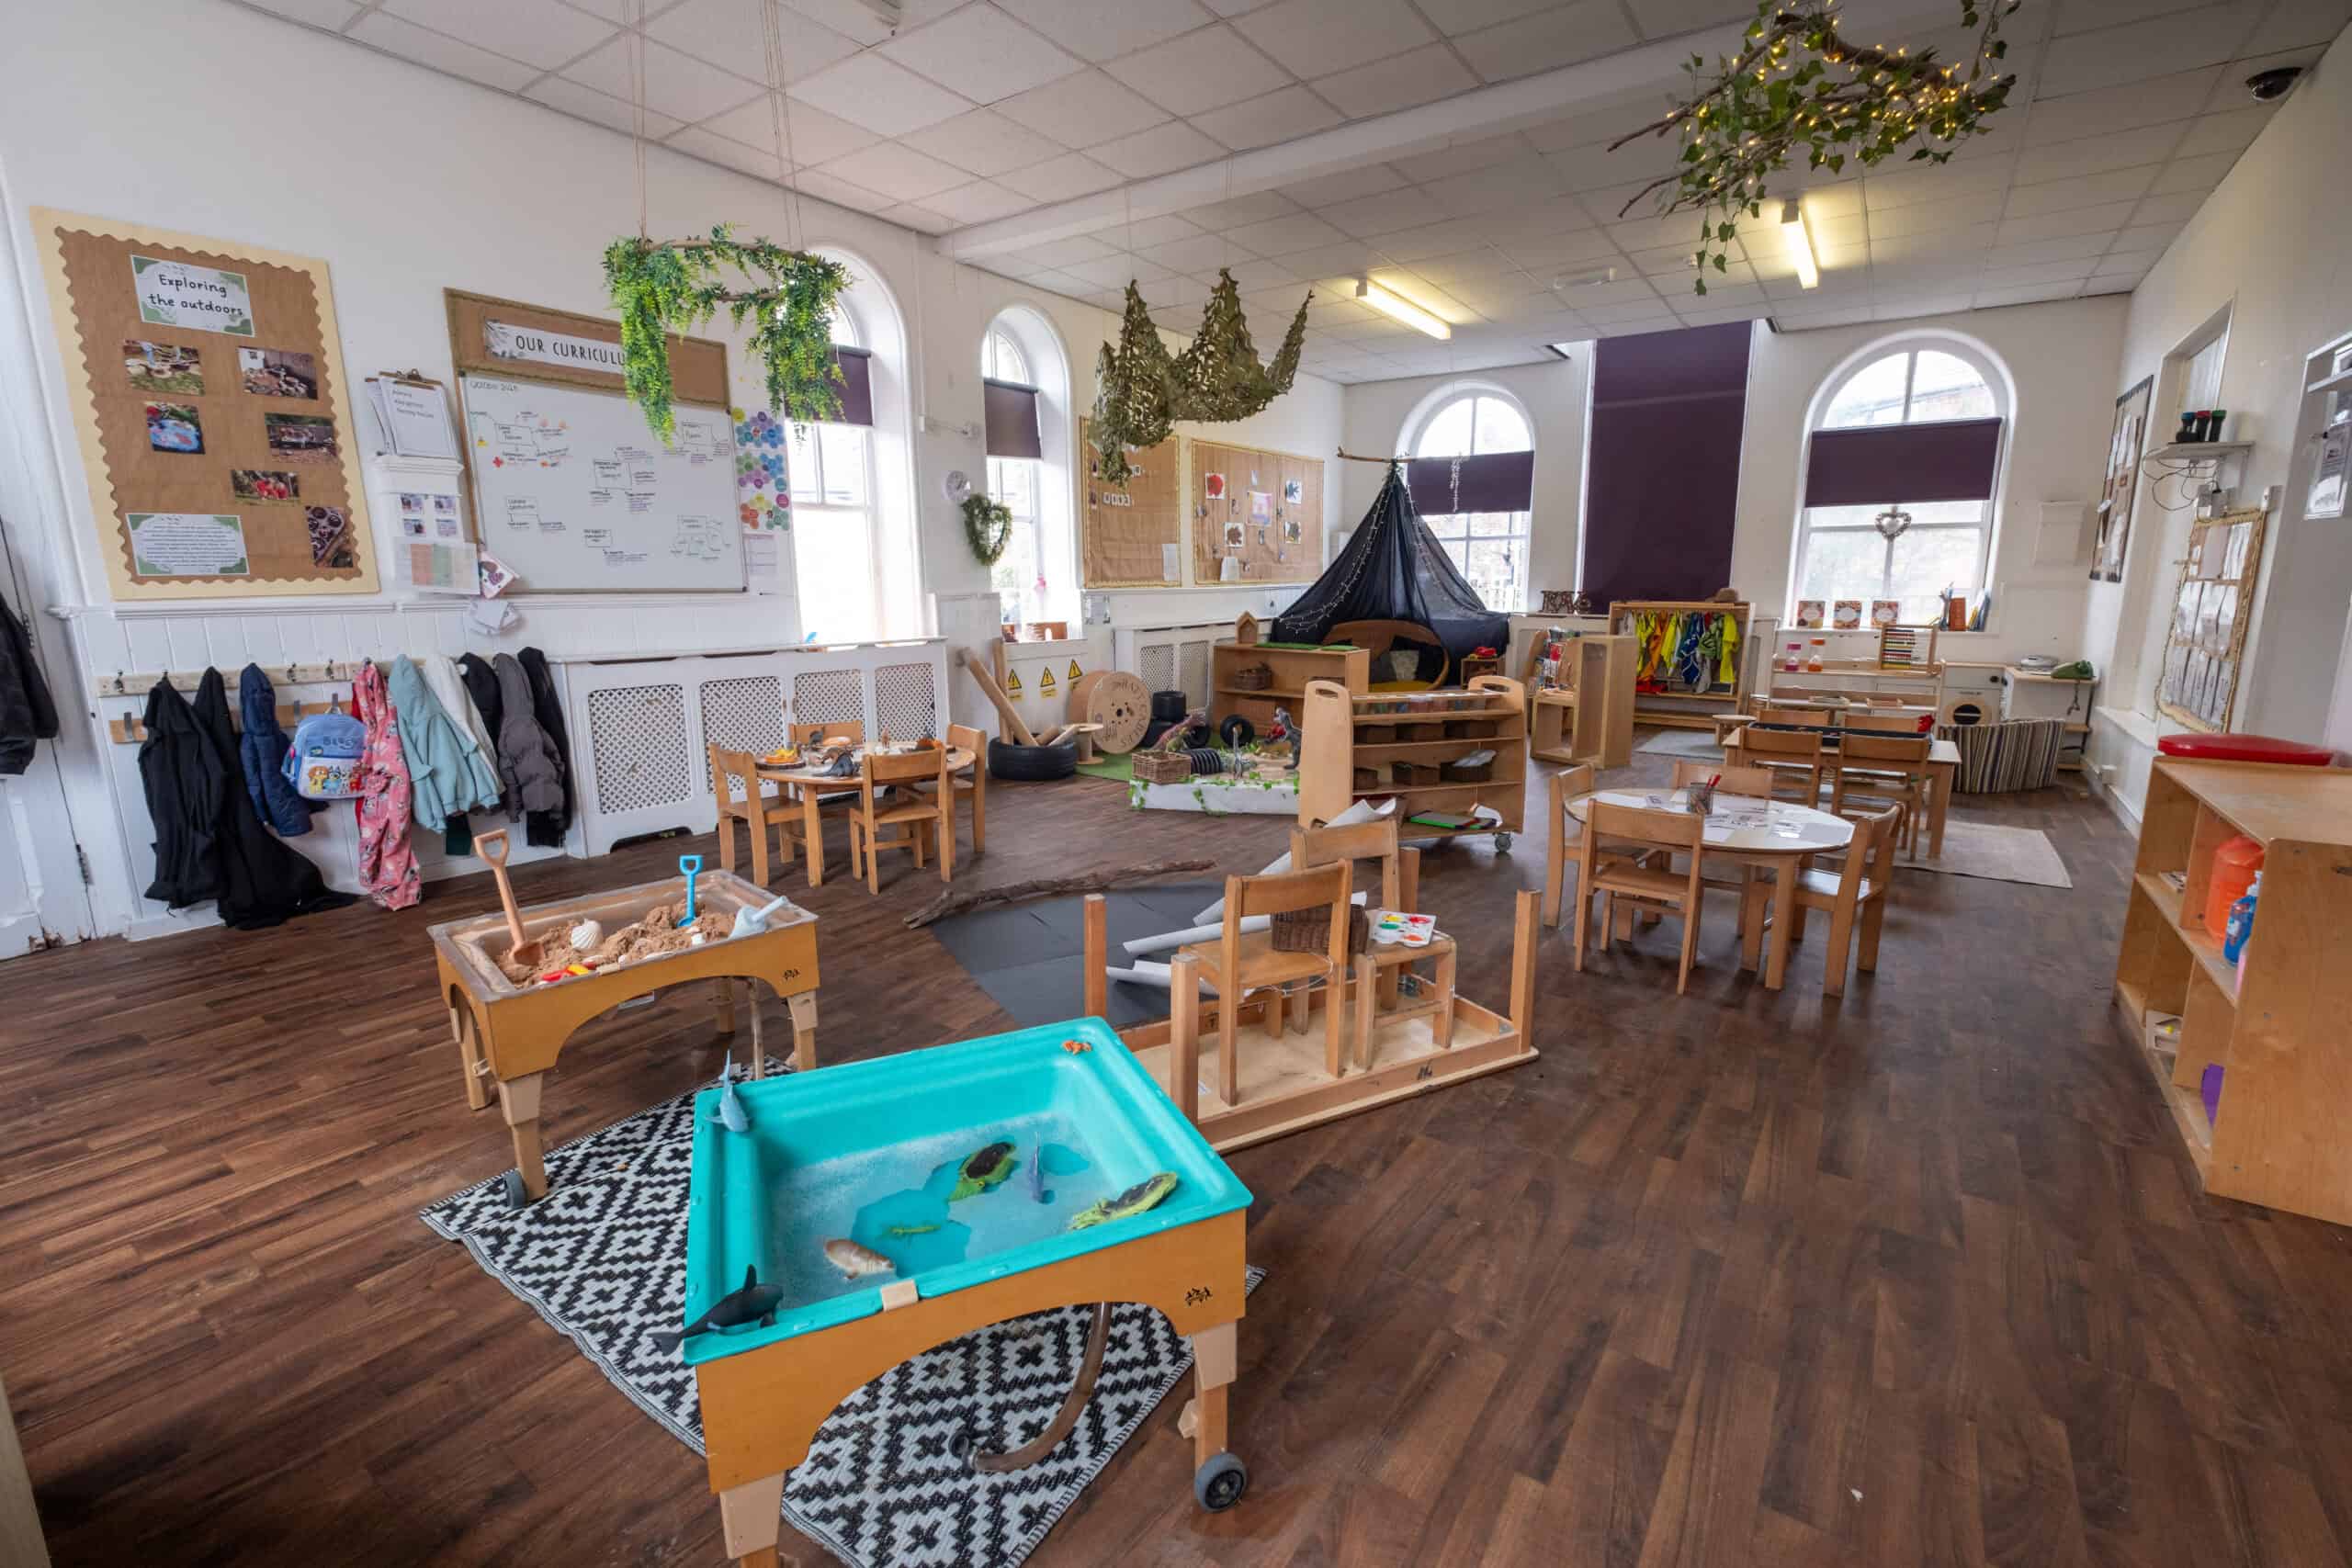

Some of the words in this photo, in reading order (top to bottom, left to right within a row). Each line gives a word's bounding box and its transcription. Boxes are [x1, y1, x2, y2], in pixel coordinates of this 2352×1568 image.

[159, 274, 227, 298] Exploring
[148, 293, 175, 306] the
[181, 299, 243, 316] outdoors
[515, 335, 545, 353] OUR
[552, 342, 625, 366] CURRICULU
